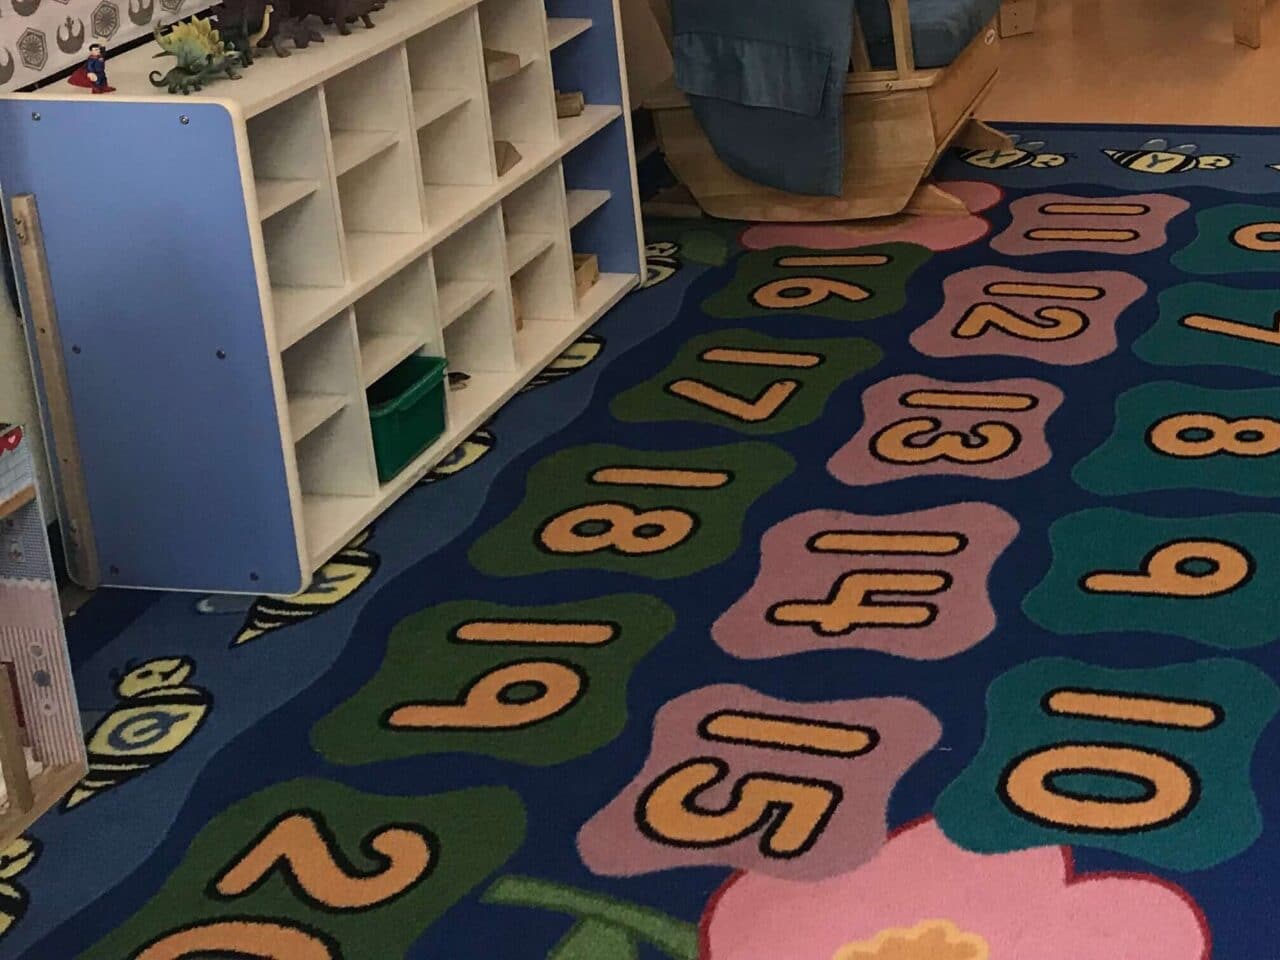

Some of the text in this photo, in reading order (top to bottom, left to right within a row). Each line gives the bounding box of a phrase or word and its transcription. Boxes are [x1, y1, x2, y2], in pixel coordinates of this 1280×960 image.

[1144, 155, 1175, 168] Y
[749, 254, 892, 310] 16
[951, 280, 1106, 341] 12
[665, 346, 826, 422] 17
[869, 388, 1038, 464] 13
[534, 466, 735, 556] 18
[765, 530, 968, 636] 14
[380, 619, 621, 731] 19
[108, 711, 191, 751] Q
[997, 686, 1225, 834] 10
[635, 709, 880, 859] 15
